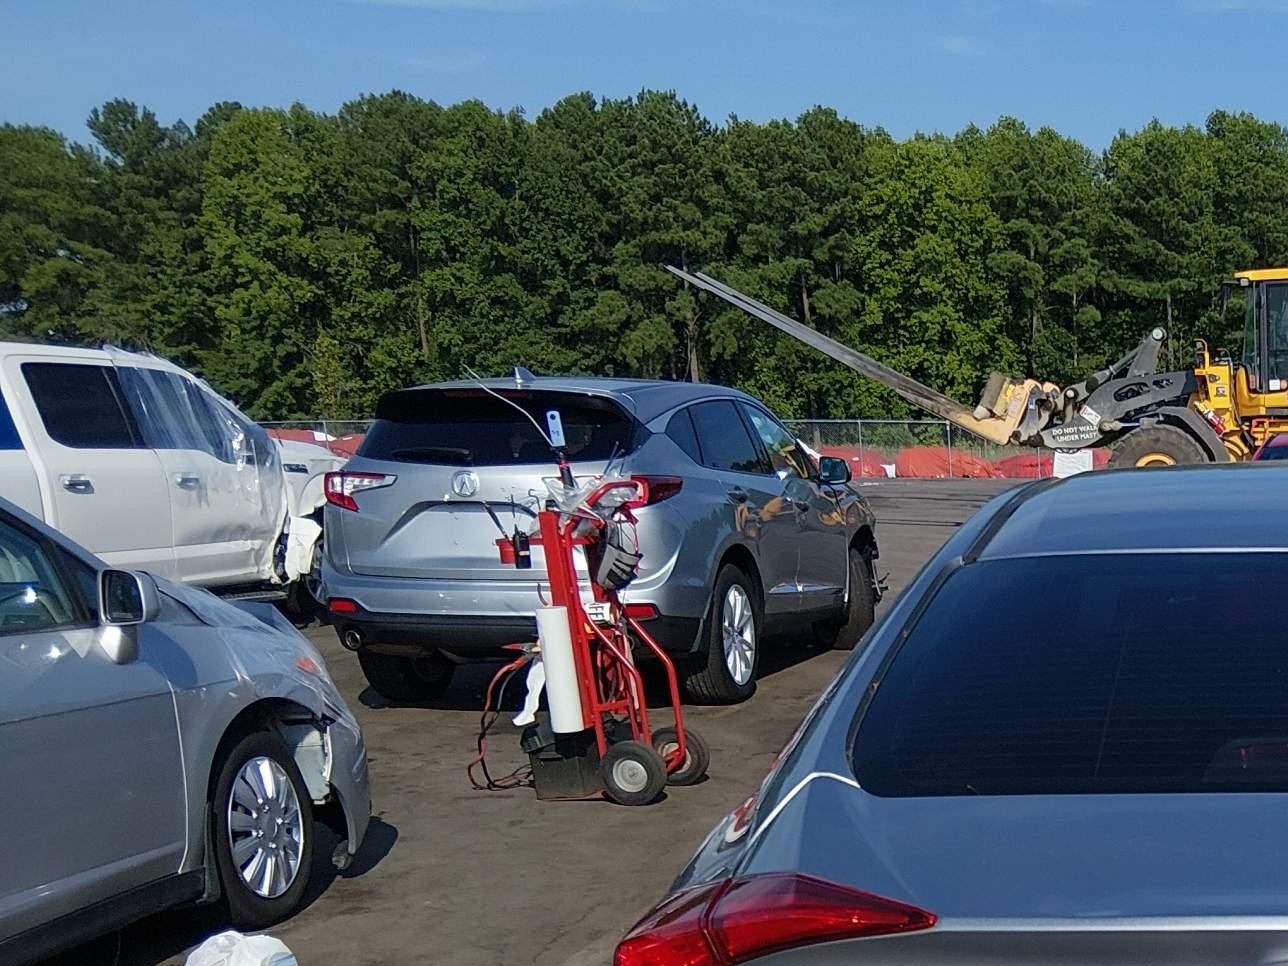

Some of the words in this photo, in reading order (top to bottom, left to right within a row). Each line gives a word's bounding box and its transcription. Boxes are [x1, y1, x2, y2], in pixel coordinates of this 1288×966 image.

[1052, 428, 1063, 436] DO
[1063, 426, 1078, 435] NOT
[1056, 434, 1080, 442] UNDER
[1080, 432, 1097, 441] MAST
